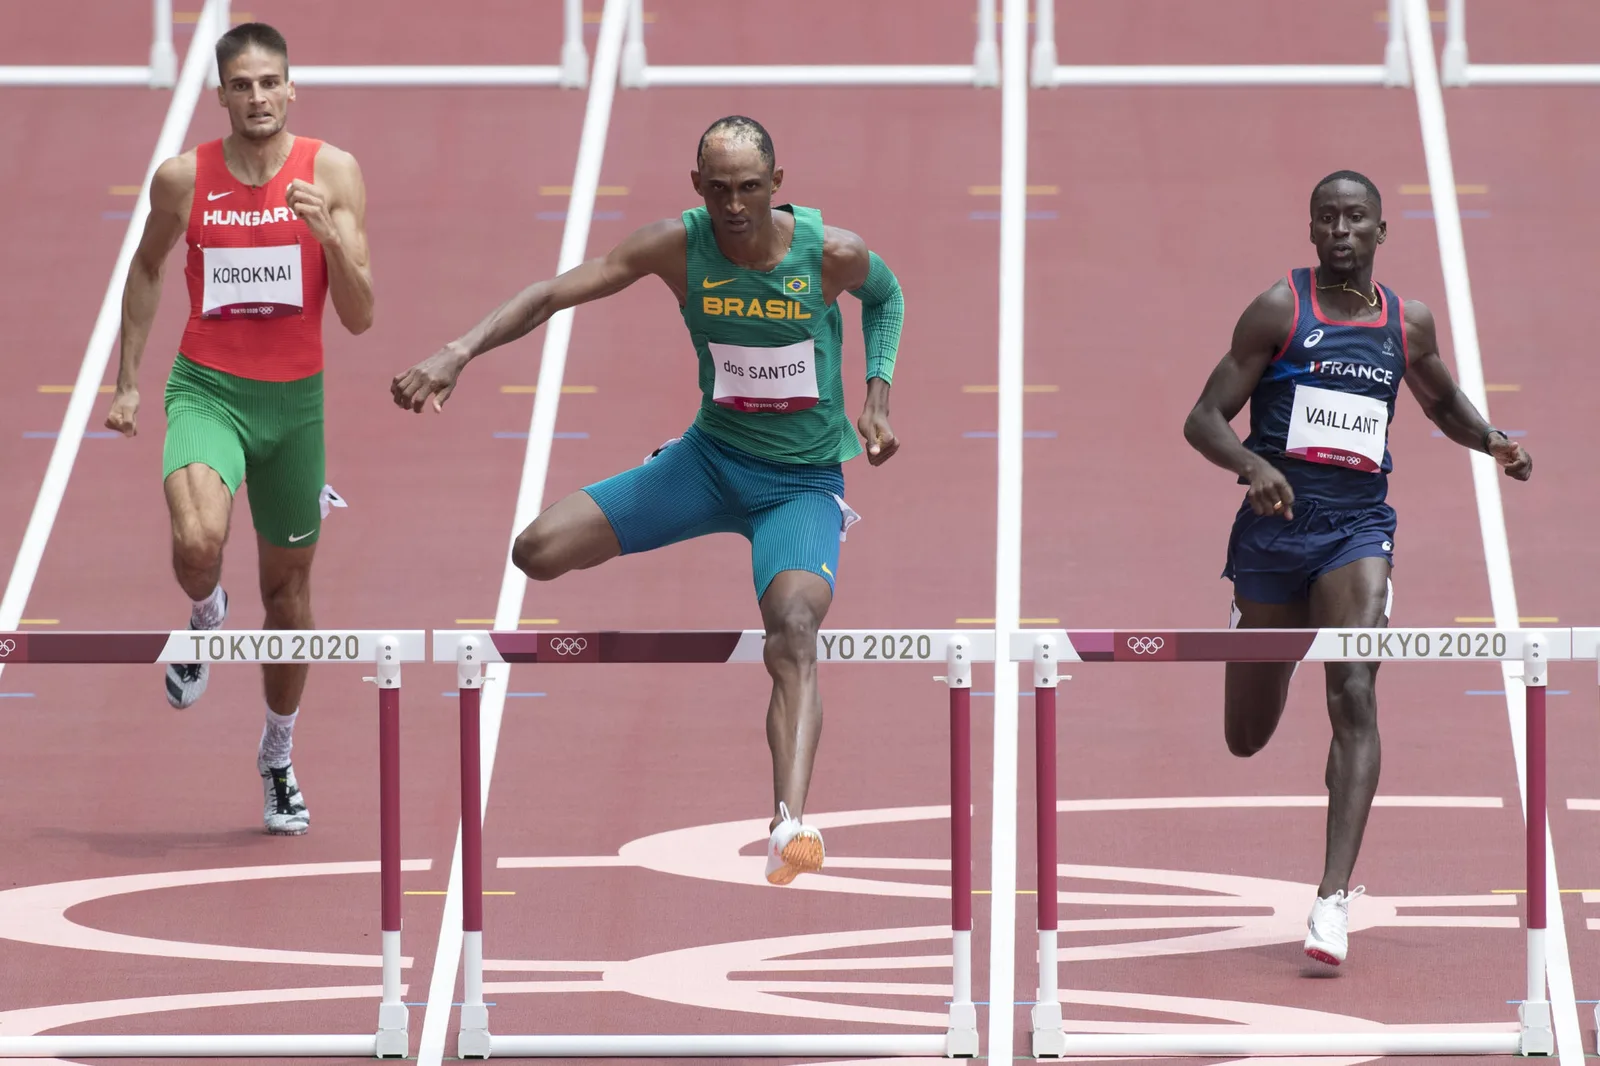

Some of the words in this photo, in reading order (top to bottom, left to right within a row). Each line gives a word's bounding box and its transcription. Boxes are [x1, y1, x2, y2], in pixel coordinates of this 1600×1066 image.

[213, 265, 291, 283] KOROKNAI
[703, 296, 811, 319] BRASIL
[723, 360, 744, 376] dos
[749, 361, 805, 379] SANTOS
[1320, 361, 1392, 385] FRANCE
[1306, 406, 1379, 435] VAILLANT
[1333, 454, 1345, 462] 2020
[190, 635, 283, 660] TOKYO
[291, 635, 360, 660] 2020
[863, 634, 931, 659] 2020
[1337, 633, 1430, 658] TOKYO
[1439, 633, 1507, 658] 2020
